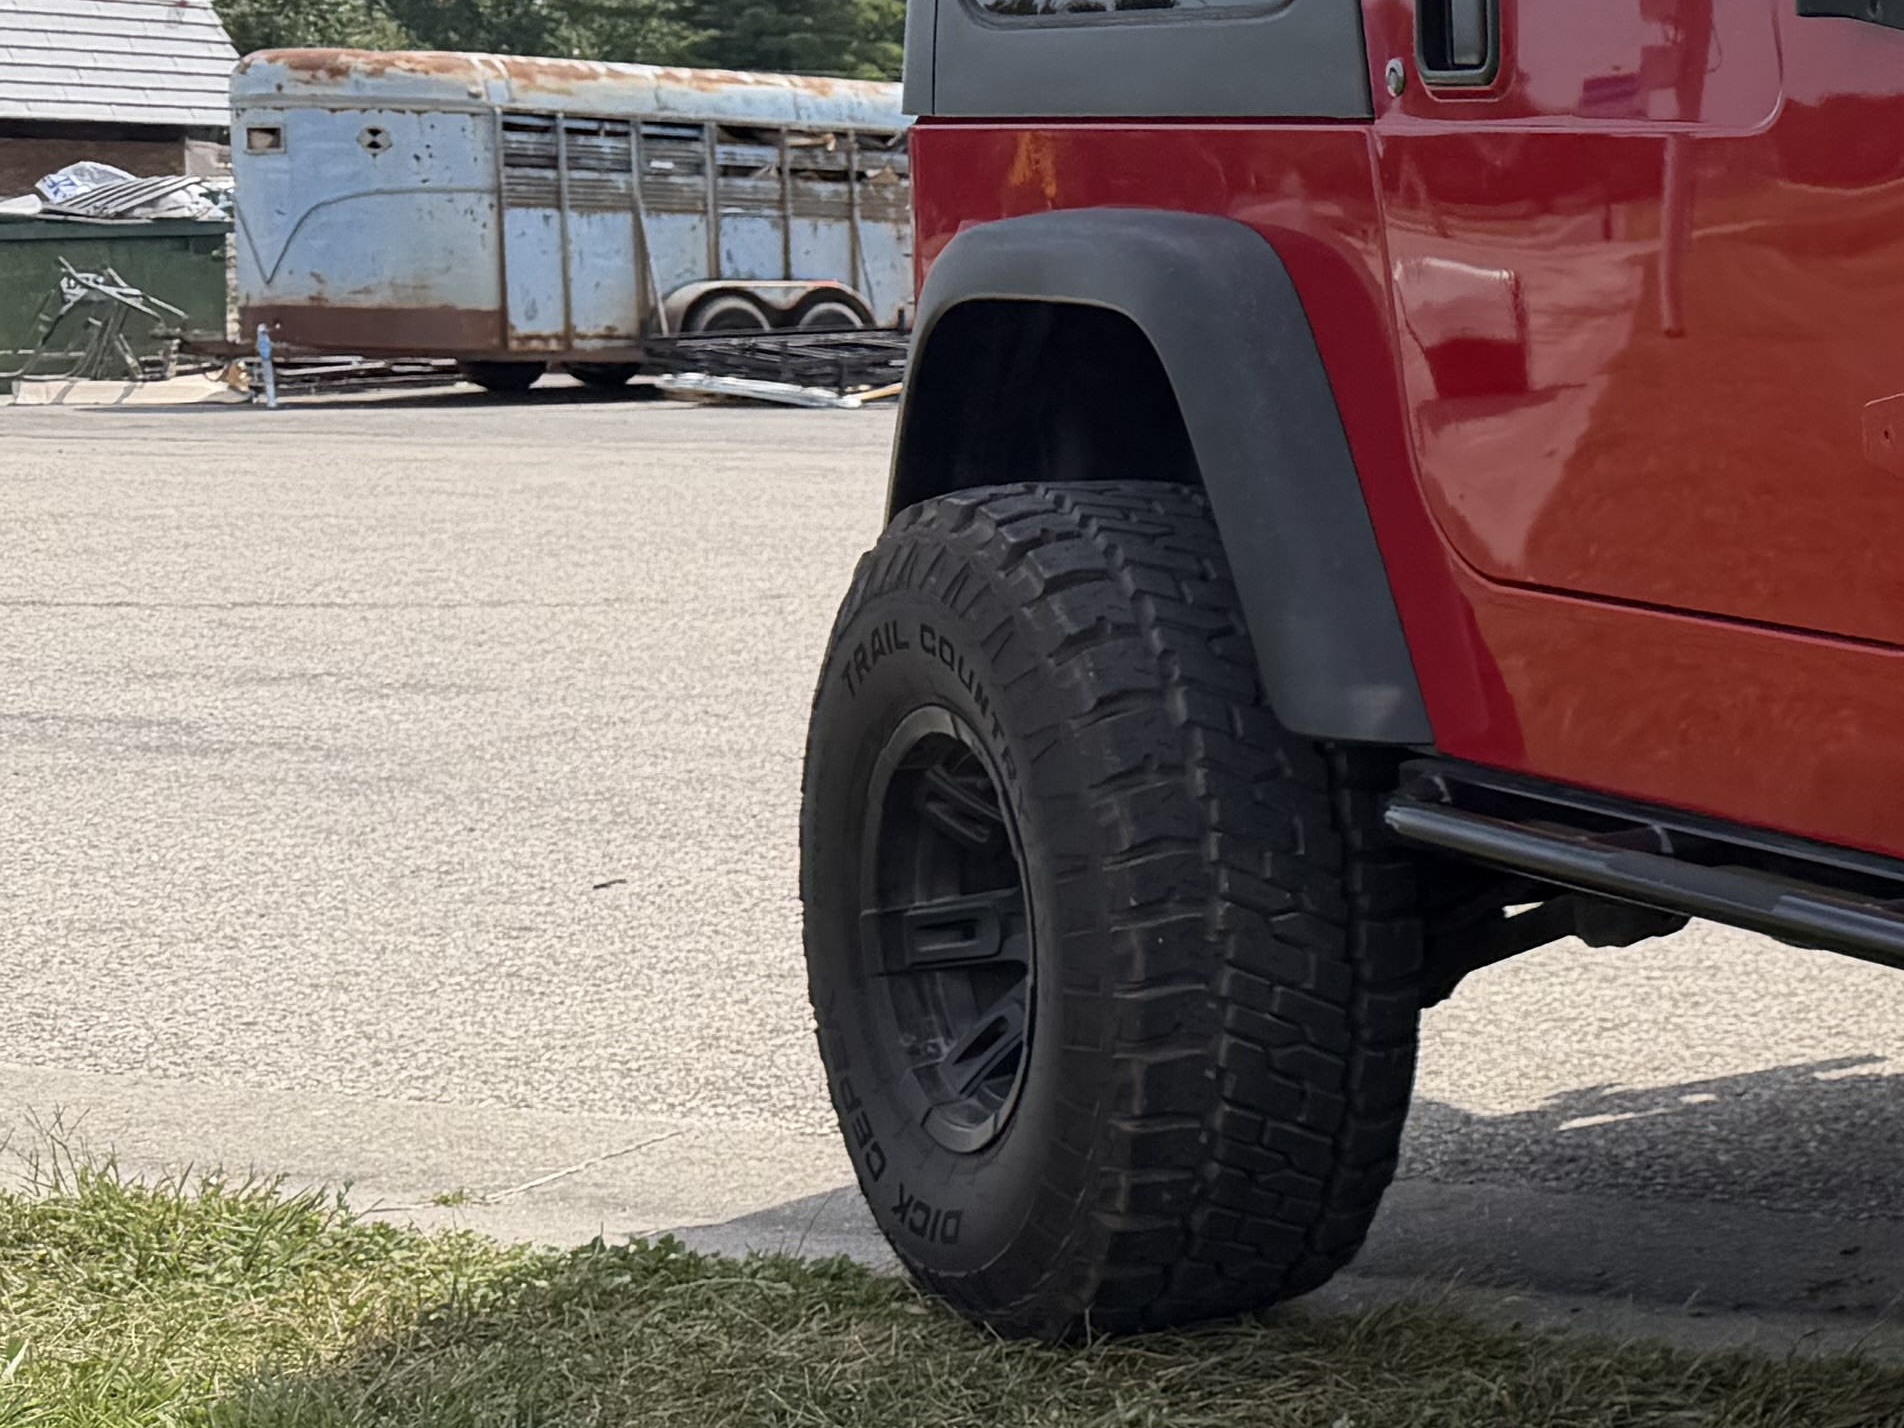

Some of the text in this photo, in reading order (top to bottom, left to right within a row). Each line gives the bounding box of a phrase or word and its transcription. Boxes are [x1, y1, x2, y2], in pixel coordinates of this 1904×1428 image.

[841, 618, 1028, 828] TRAIL COUNTRY
[824, 990, 964, 1245] DICK CEPEK
